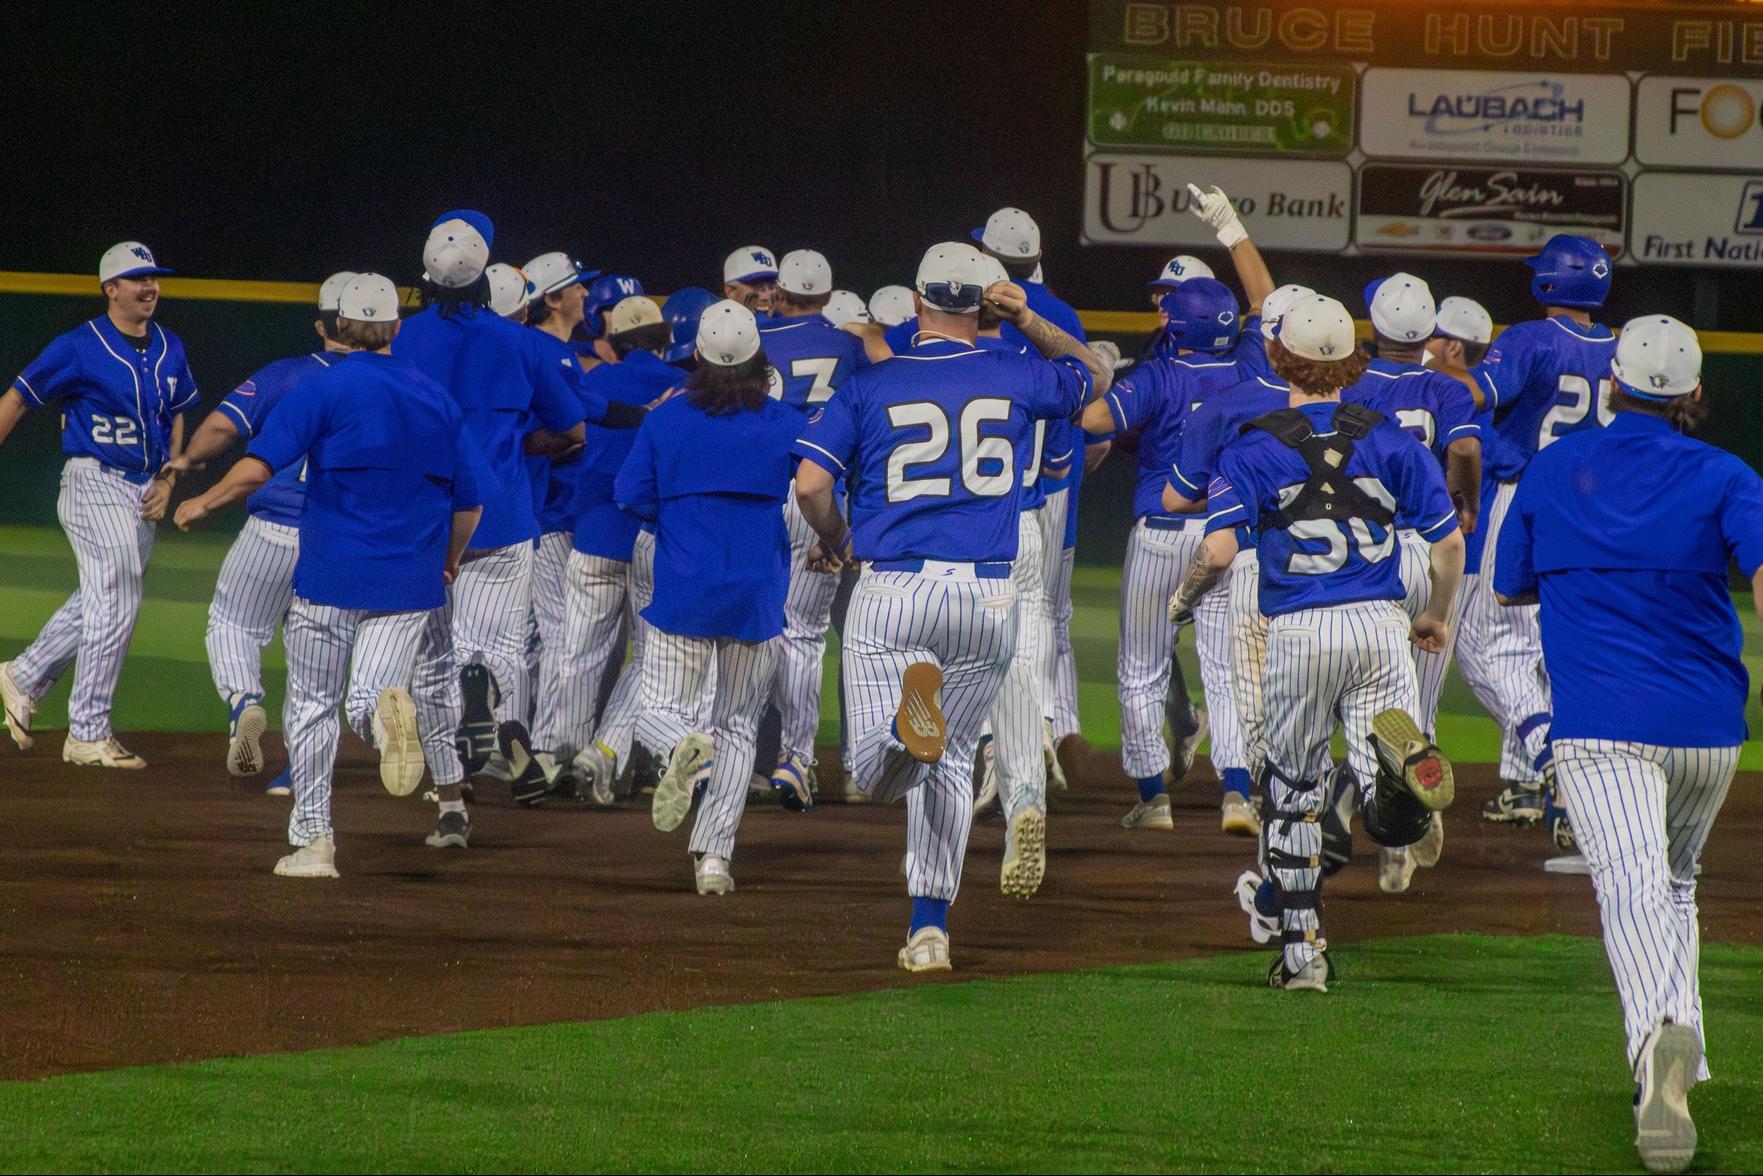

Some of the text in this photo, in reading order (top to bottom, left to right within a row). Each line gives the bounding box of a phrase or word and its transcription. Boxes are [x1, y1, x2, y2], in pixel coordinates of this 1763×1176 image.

[1124, 3, 1375, 51] BRUCE
[1424, 13, 1624, 59] HUNT
[1195, 69, 1254, 91] Family
[1259, 71, 1341, 95] Dentistry
[1147, 97, 1196, 114] Kevin
[1267, 192, 1345, 218] Bank
[1418, 171, 1487, 216] Glen
[1643, 234, 1763, 260] First Nati
[91, 413, 138, 445] 22
[886, 397, 1015, 503] 26
